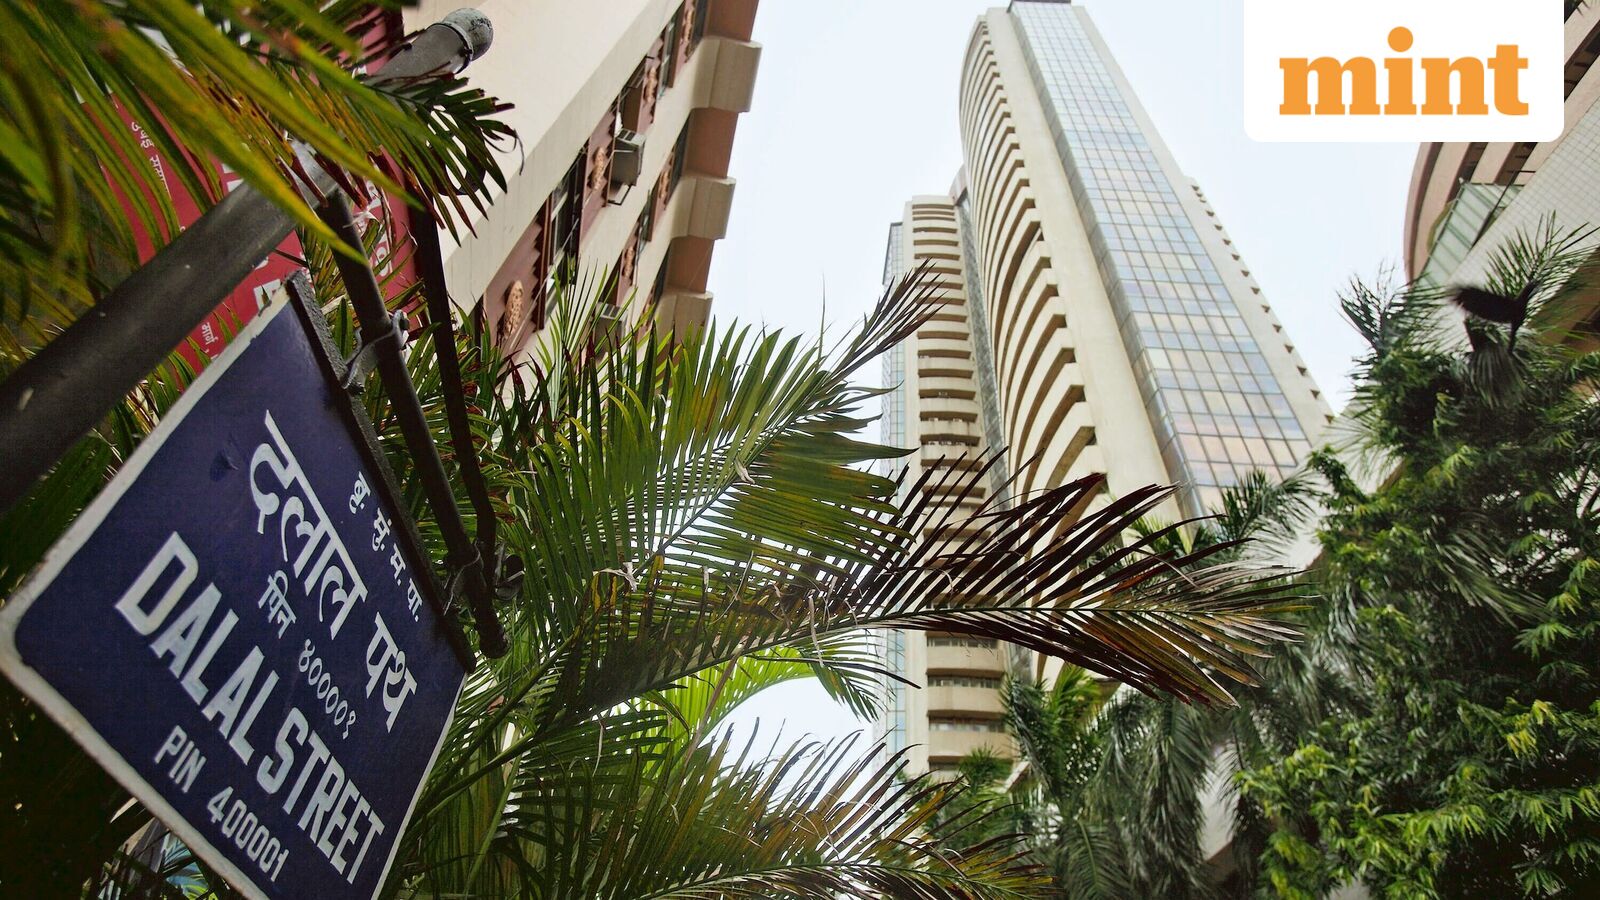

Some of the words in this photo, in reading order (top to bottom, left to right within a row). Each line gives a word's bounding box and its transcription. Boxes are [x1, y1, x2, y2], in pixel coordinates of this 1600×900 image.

[250, 410, 369, 640] दलाल
[366, 612, 417, 732] पथ
[258, 570, 297, 638] पिन
[299, 639, 356, 739] ४००००१
[115, 532, 280, 765] DALAL
[257, 708, 385, 884] STREET
[155, 726, 207, 793] PIN
[207, 786, 289, 882] 400001
